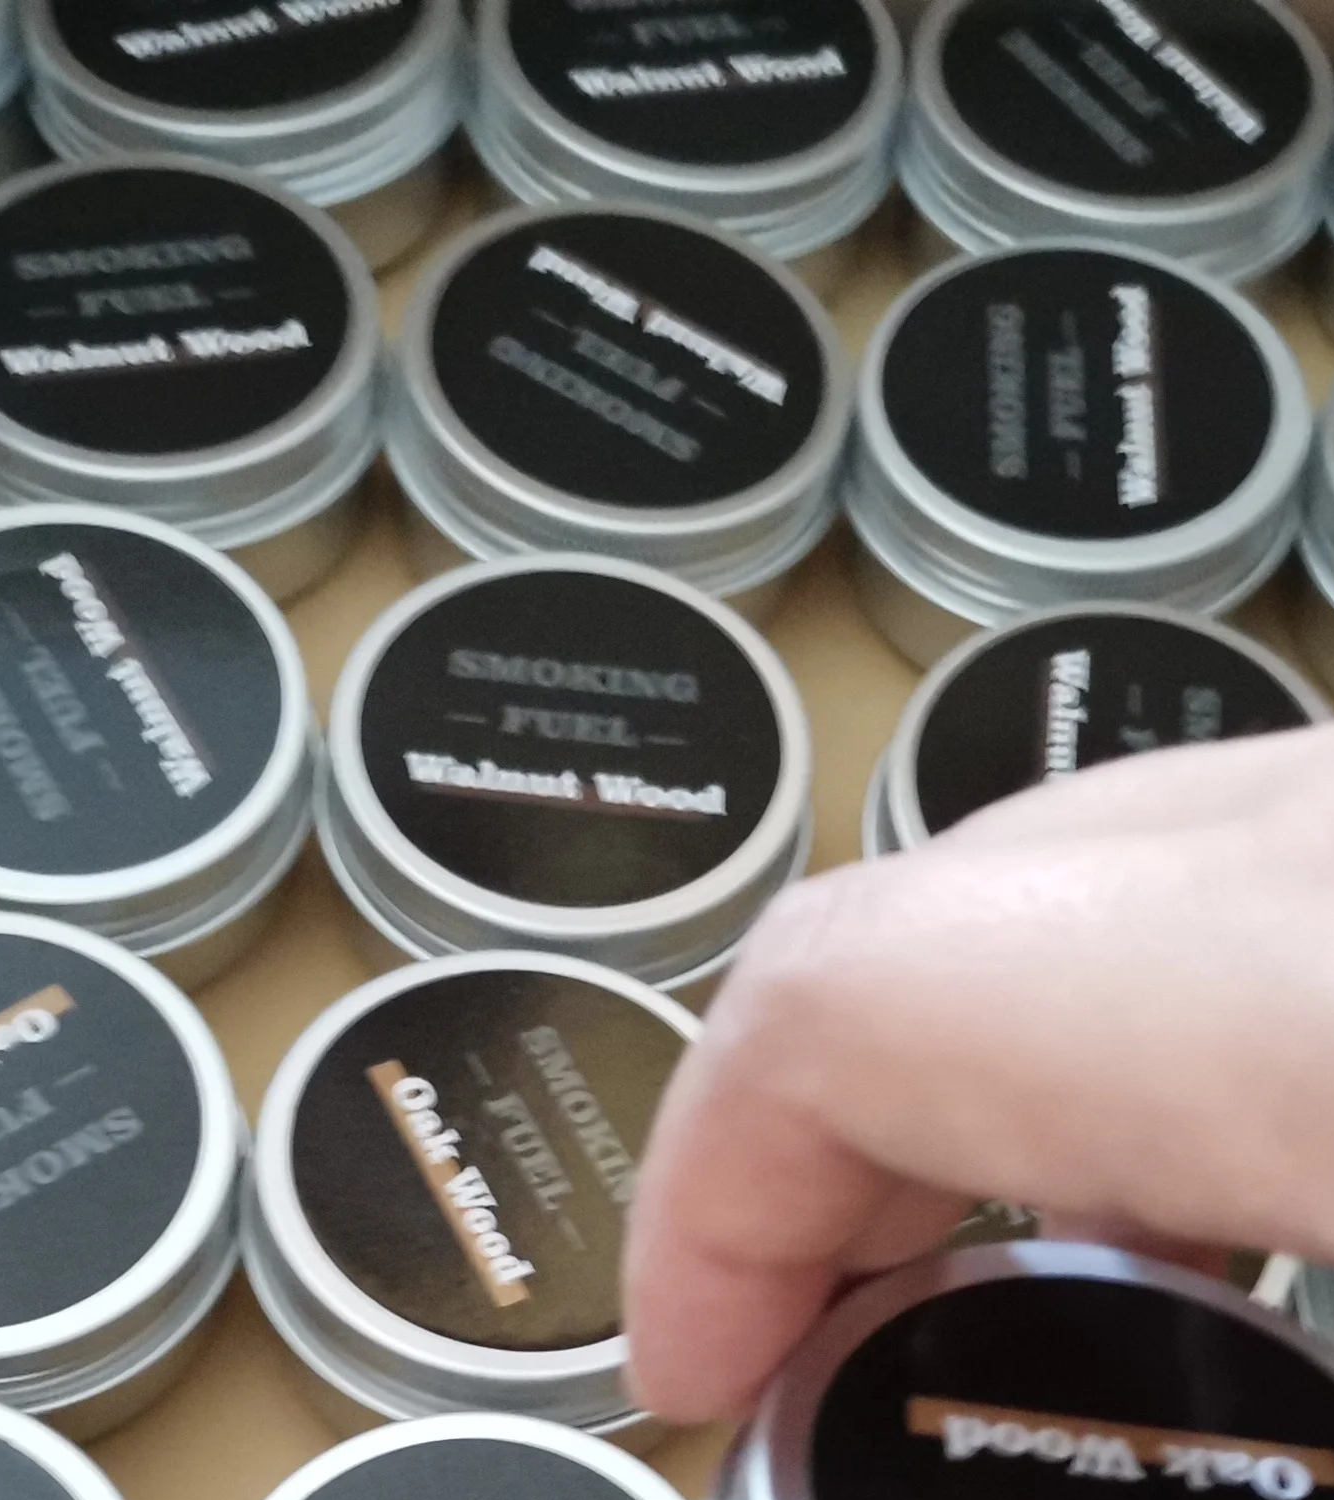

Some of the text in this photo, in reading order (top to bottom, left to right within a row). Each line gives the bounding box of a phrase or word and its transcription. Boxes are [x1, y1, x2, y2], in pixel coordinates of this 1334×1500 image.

[37, 551, 214, 800] Walnut Wood
[445, 645, 703, 706] SMOKING
[496, 703, 642, 749] FUEL
[404, 750, 727, 816] Walnut Wood
[392, 1075, 537, 1286] Oak Wood
[482, 1090, 575, 1214] FUEL
[941, 1412, 1148, 1485] Wood
